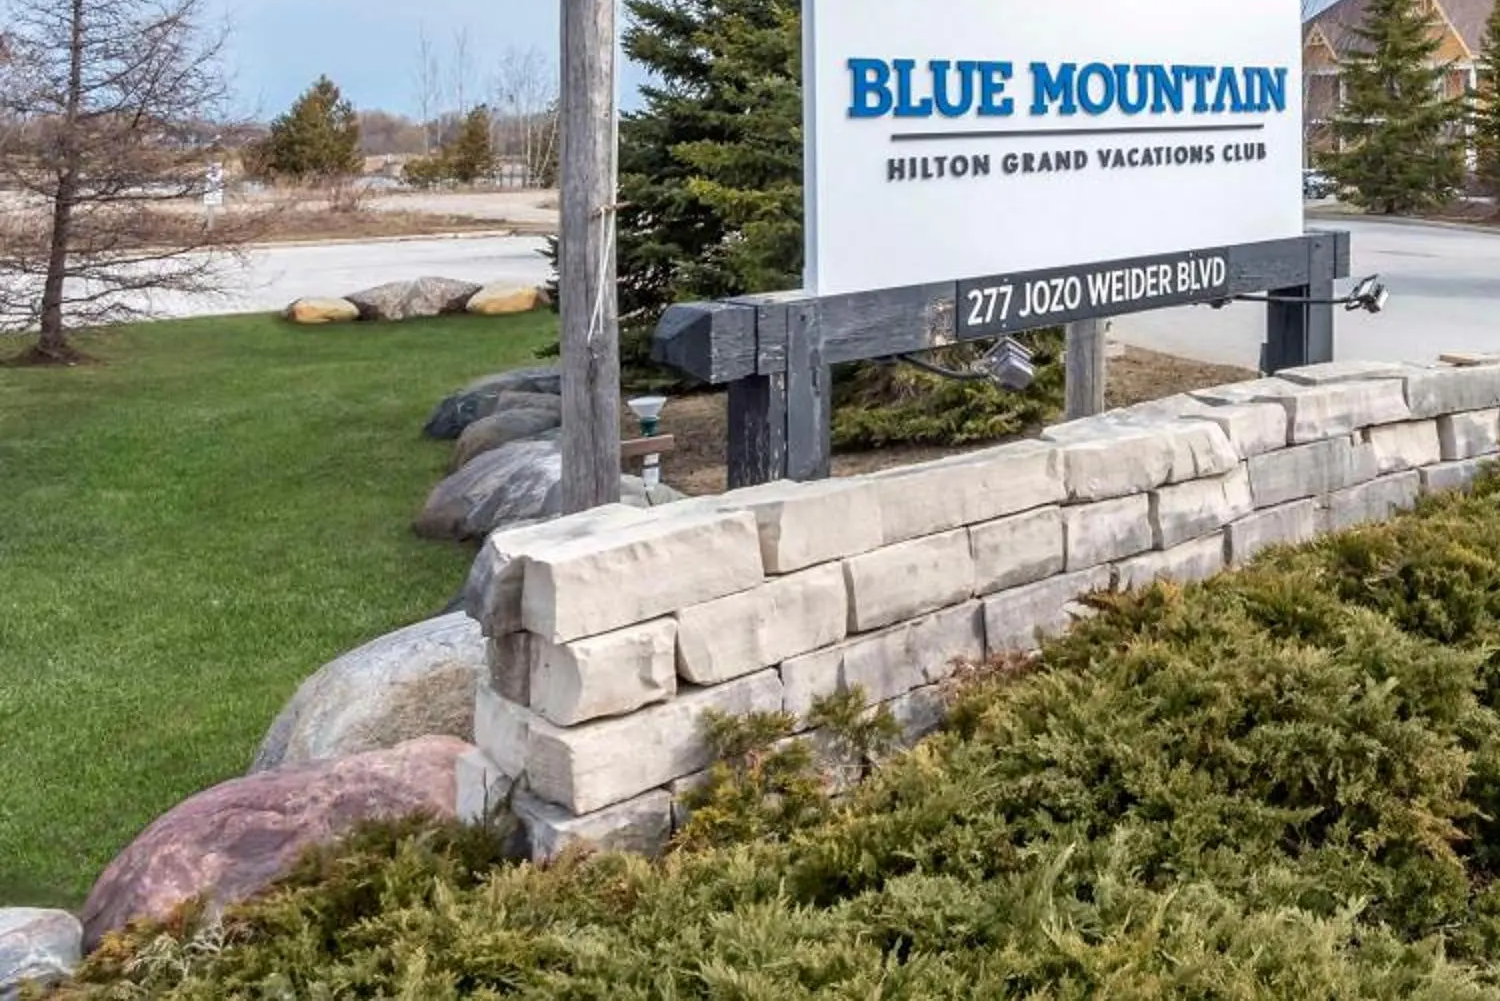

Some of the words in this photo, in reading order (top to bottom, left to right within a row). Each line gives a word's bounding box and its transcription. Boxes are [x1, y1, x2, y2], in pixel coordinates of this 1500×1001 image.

[847, 58, 1013, 118] BLUE
[1029, 62, 1287, 117] MOUNTAIN
[887, 154, 991, 181] HILTON
[1002, 149, 1089, 175] GRAND
[1097, 144, 1215, 169] VACATIONS
[1222, 142, 1267, 162] CLUB
[966, 283, 1013, 327] 277
[1018, 275, 1082, 318] JOZO
[1087, 263, 1172, 307] WEIDER
[1176, 255, 1226, 293] BLVD
